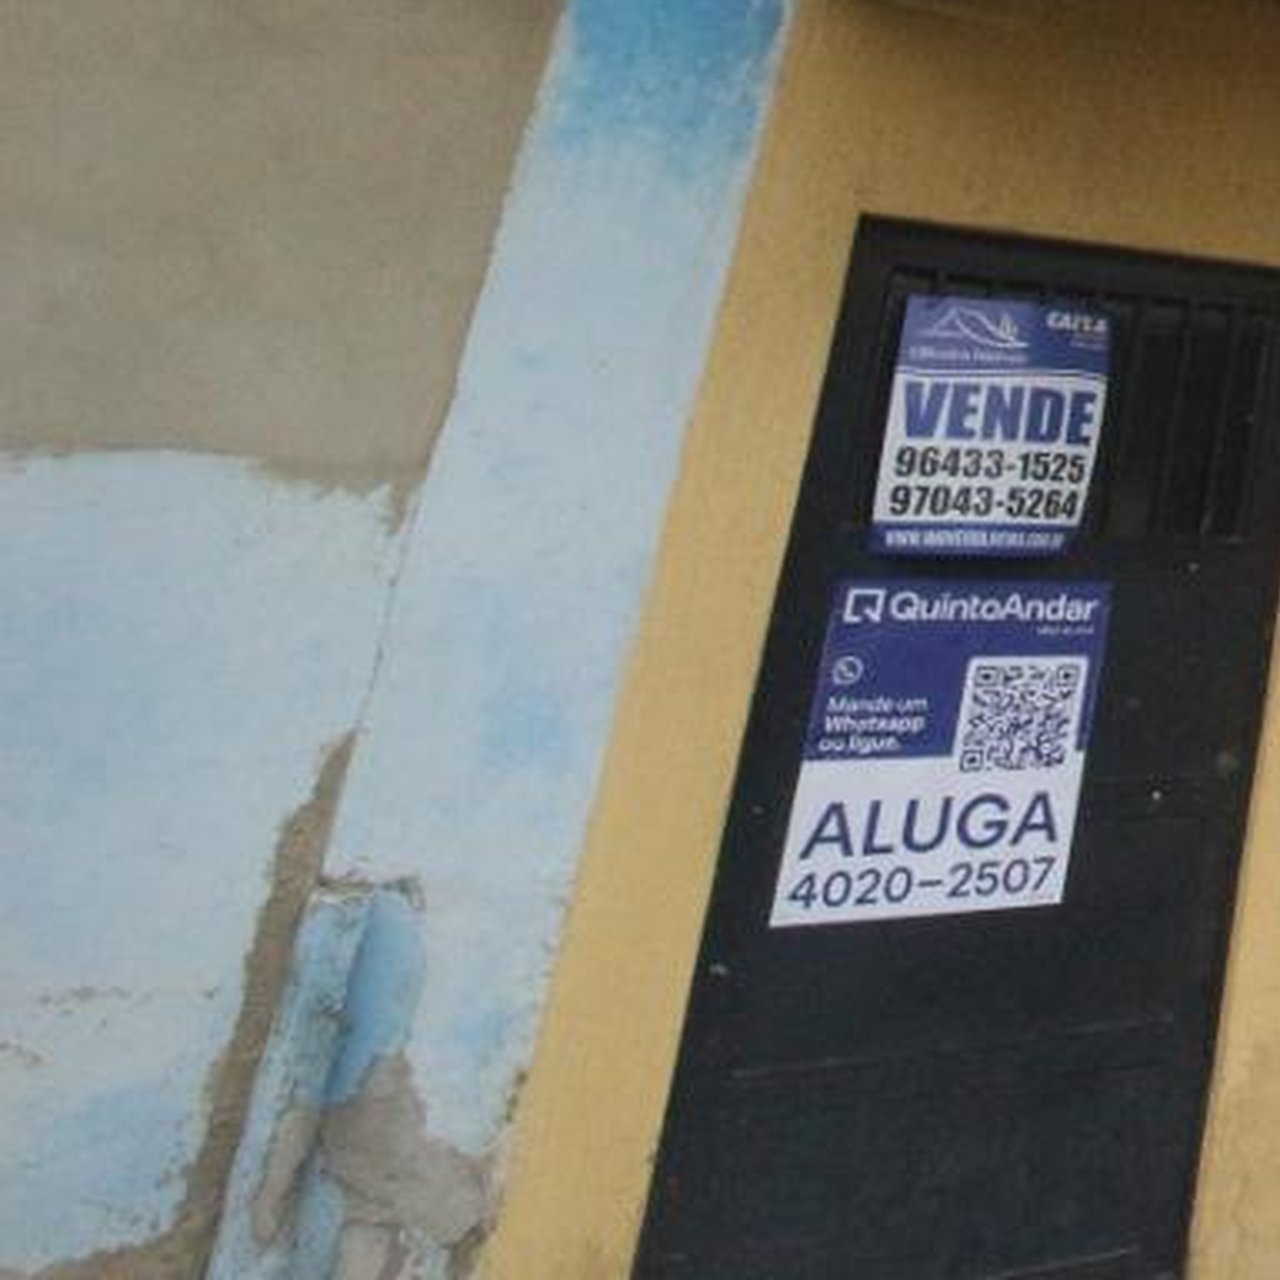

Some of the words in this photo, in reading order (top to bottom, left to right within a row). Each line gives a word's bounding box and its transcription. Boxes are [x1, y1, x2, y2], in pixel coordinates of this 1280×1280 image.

[903, 380, 1098, 448] VENDE
[893, 445, 1087, 485] 96433-1525
[888, 484, 1081, 521] 97043-5264
[889, 591, 1099, 622] QuintoAndar
[800, 790, 1058, 860] ALUGA
[788, 857, 1057, 908] 4020-2507
